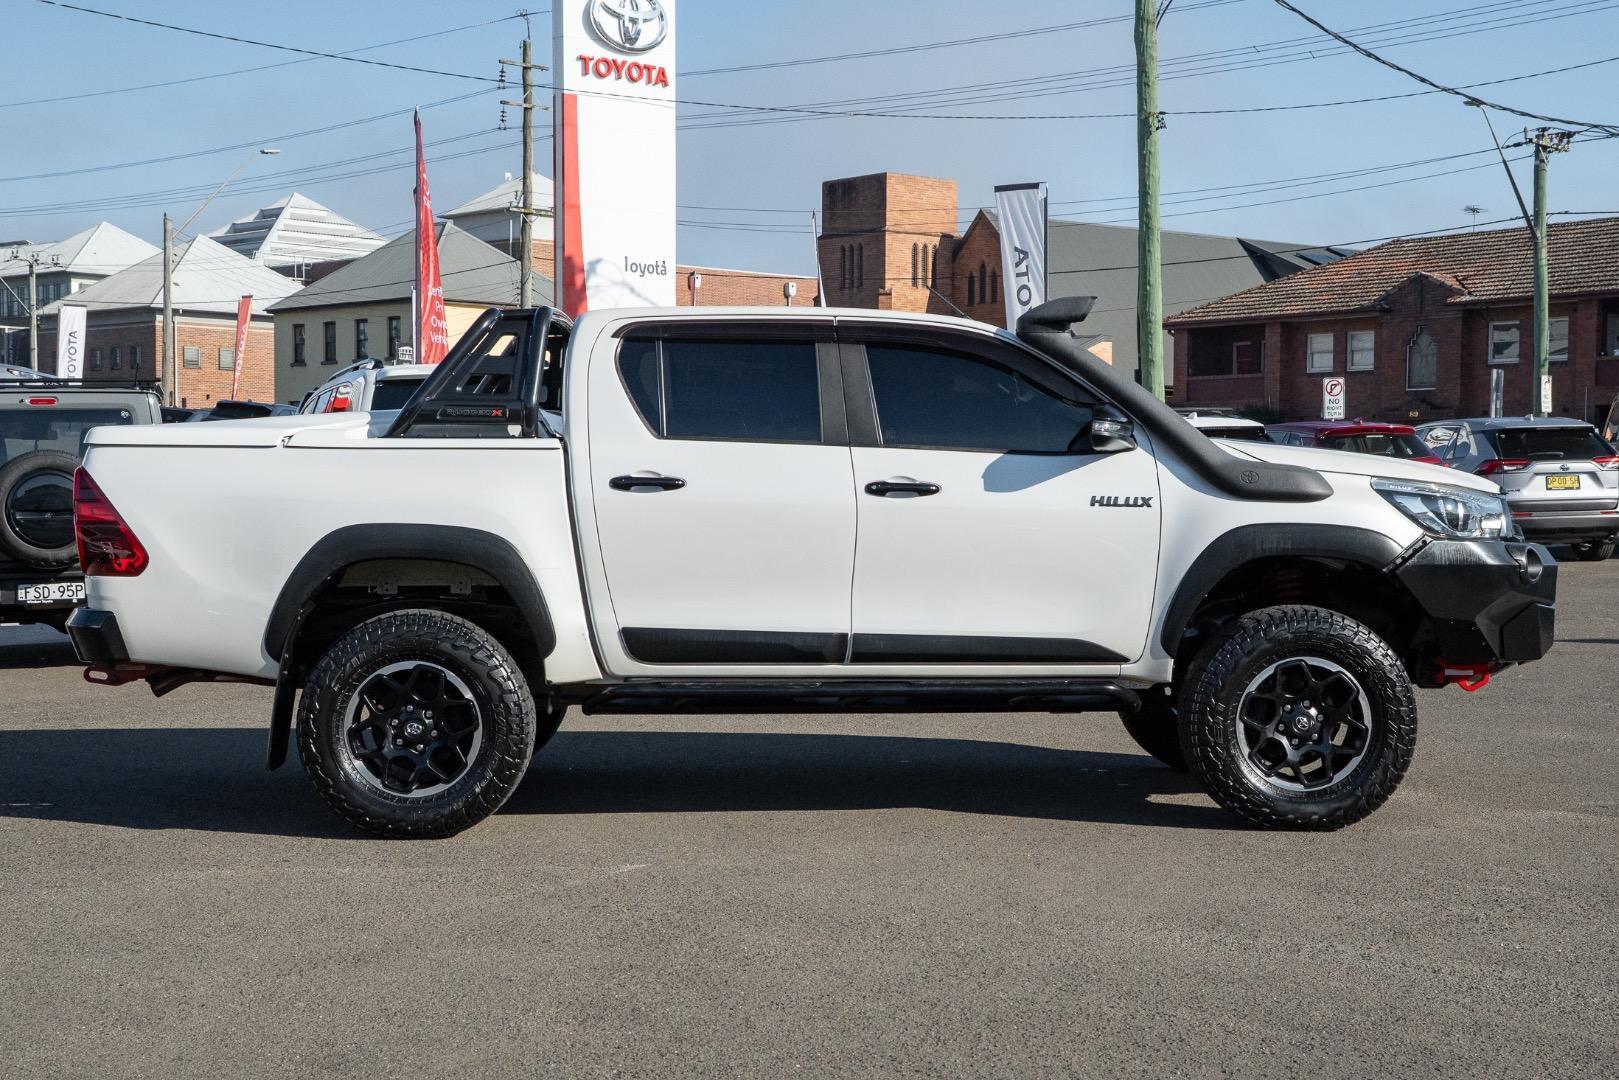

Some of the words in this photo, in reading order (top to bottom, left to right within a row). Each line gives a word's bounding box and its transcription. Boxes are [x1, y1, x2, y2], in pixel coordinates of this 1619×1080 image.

[577, 55, 669, 88] TOYOTA
[67, 330, 77, 378] TOYOTA
[1090, 495, 1153, 508] HILUX
